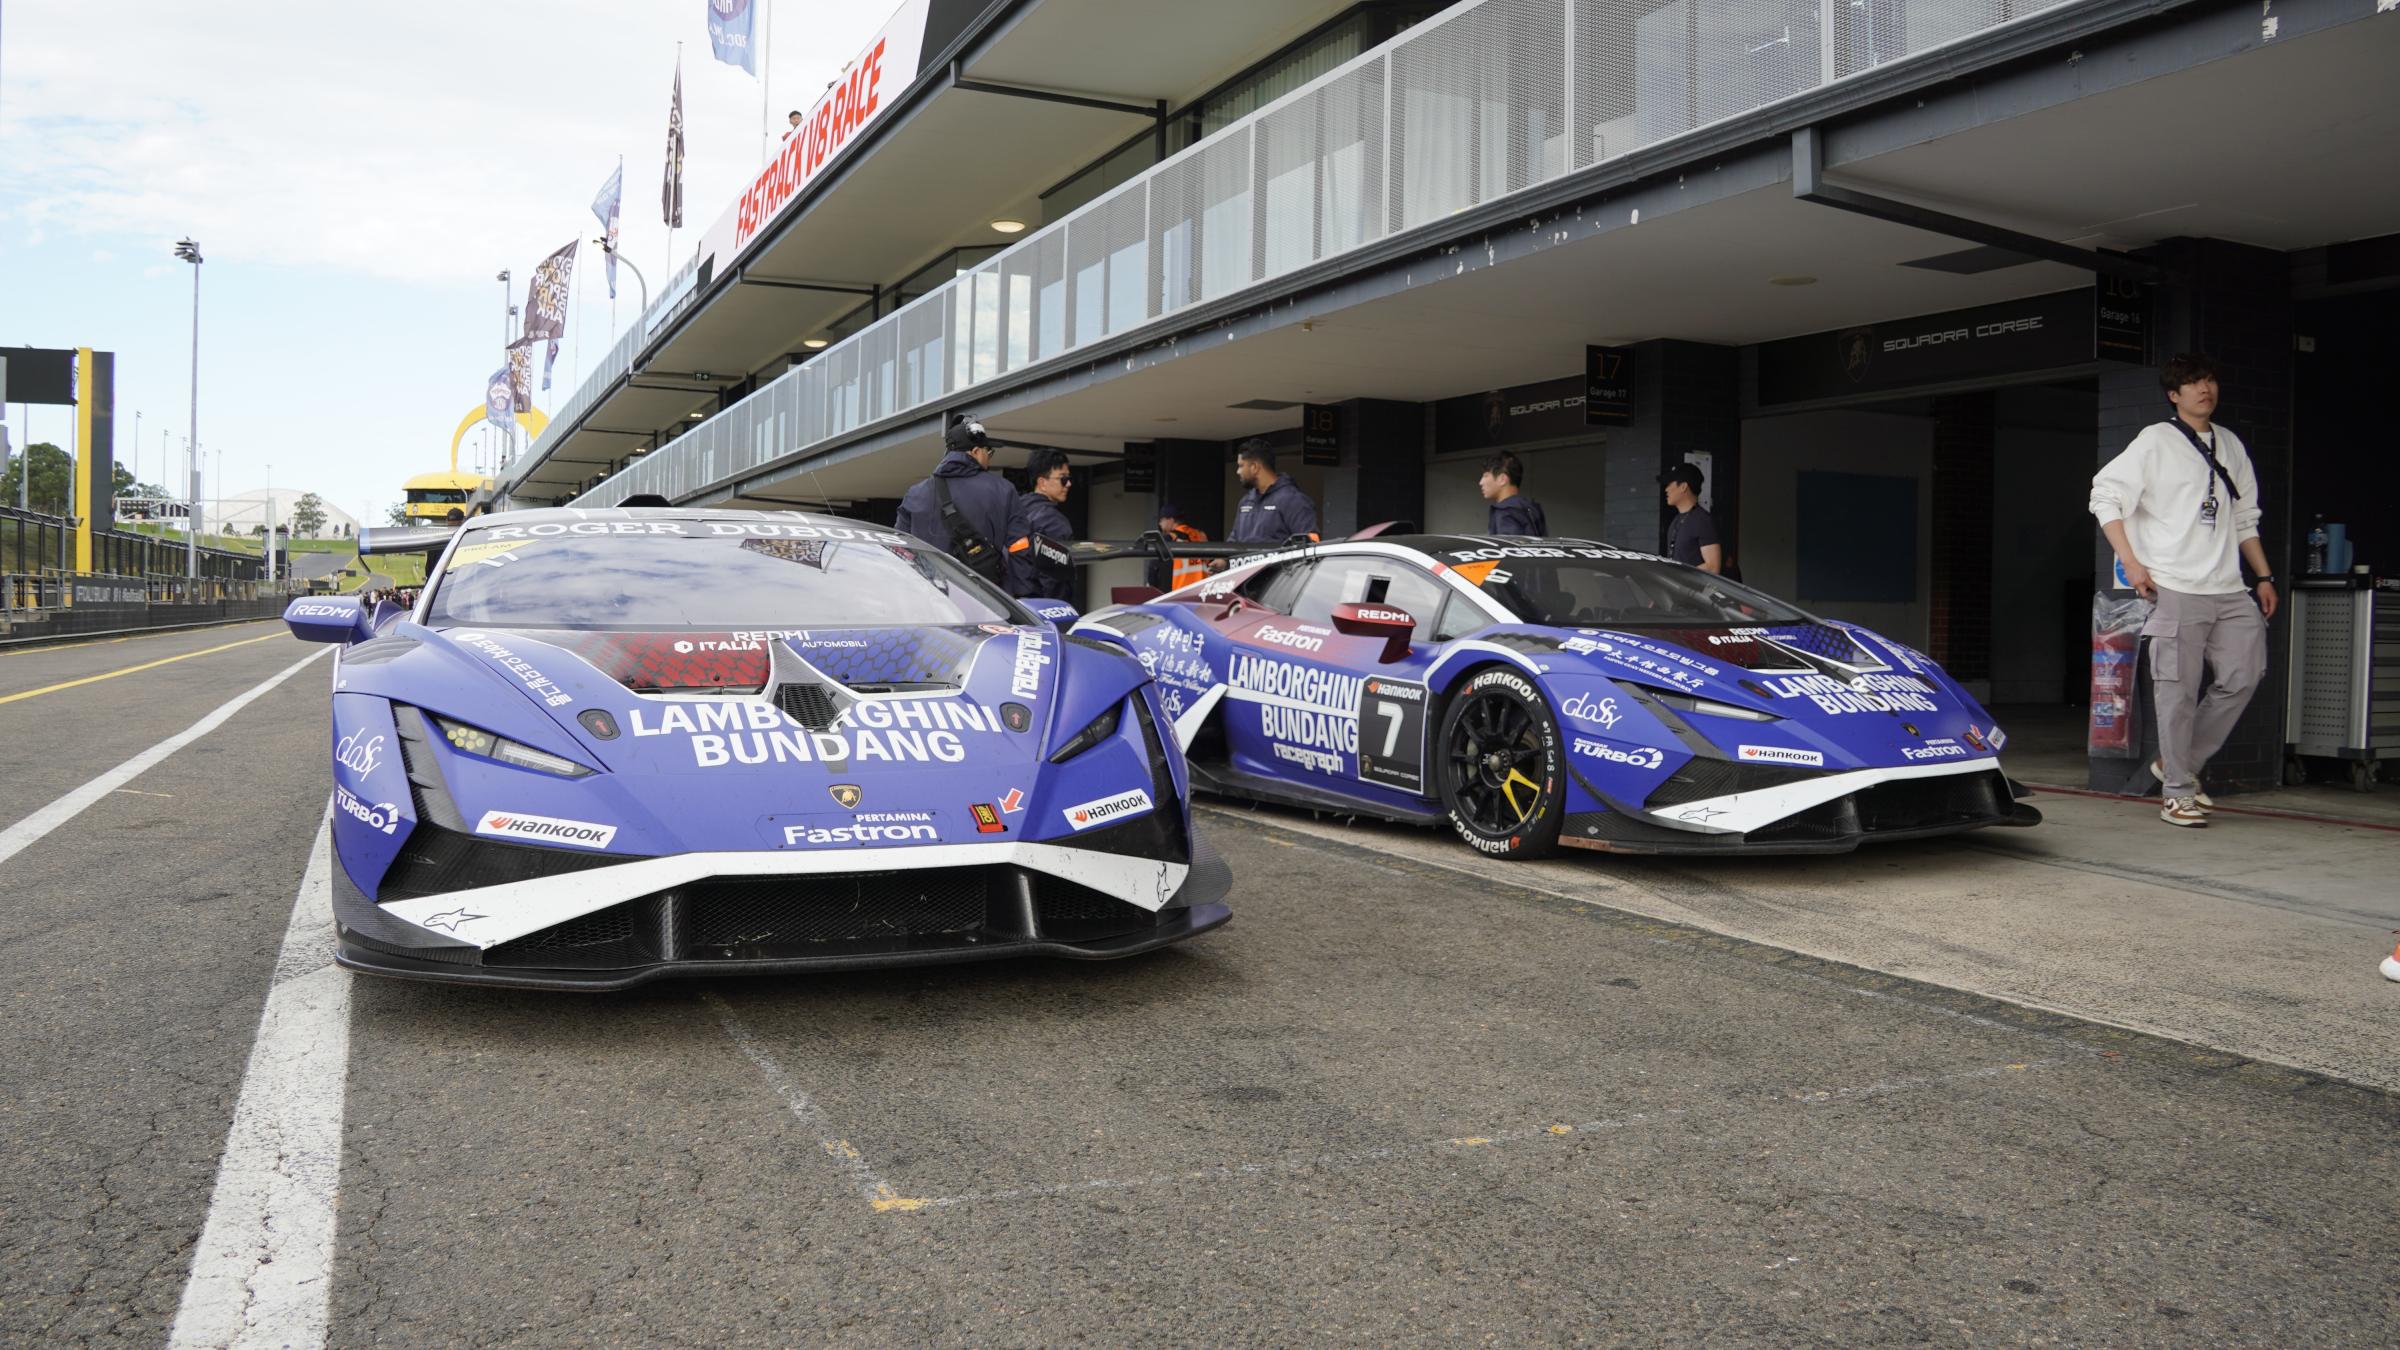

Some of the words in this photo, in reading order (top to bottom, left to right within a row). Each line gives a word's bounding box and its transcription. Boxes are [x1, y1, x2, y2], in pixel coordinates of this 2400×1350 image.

[735, 130, 807, 249] FASTRACK
[806, 100, 831, 177] V8
[829, 37, 886, 154] RACE
[2100, 307, 2129, 324] Garage
[1884, 327, 1968, 352] SQUADRA
[1976, 316, 2043, 338] CORSE
[1596, 352, 1622, 380] 17
[1590, 386, 1616, 399] Garage
[1510, 401, 1561, 416] SQUADRA
[1311, 410, 1334, 431] 18
[488, 521, 687, 541] ROGER
[711, 522, 907, 545] DUBUIS
[1040, 545, 1069, 564] macron
[1450, 548, 1573, 562] ROGER
[292, 604, 357, 619] REDMI
[1038, 606, 1078, 619] REDMI
[1358, 608, 1410, 623] REDMI
[700, 641, 761, 651] ITALIA
[733, 631, 810, 642] REDMI
[1254, 624, 1324, 652] Fastron
[1720, 635, 1753, 643] ITALIA
[1809, 692, 1938, 715] BUNDANG
[1262, 705, 1358, 754] BUNDANG
[1377, 701, 1404, 757] 7
[692, 730, 965, 767] BUNDANG
[1273, 741, 1343, 776] racegraph
[1574, 743, 1647, 766] TURBO
[1901, 745, 1966, 760] Fastron
[337, 789, 385, 829] TURBO
[856, 812, 930, 823] PERTAMINA
[783, 824, 937, 845] Fastron
